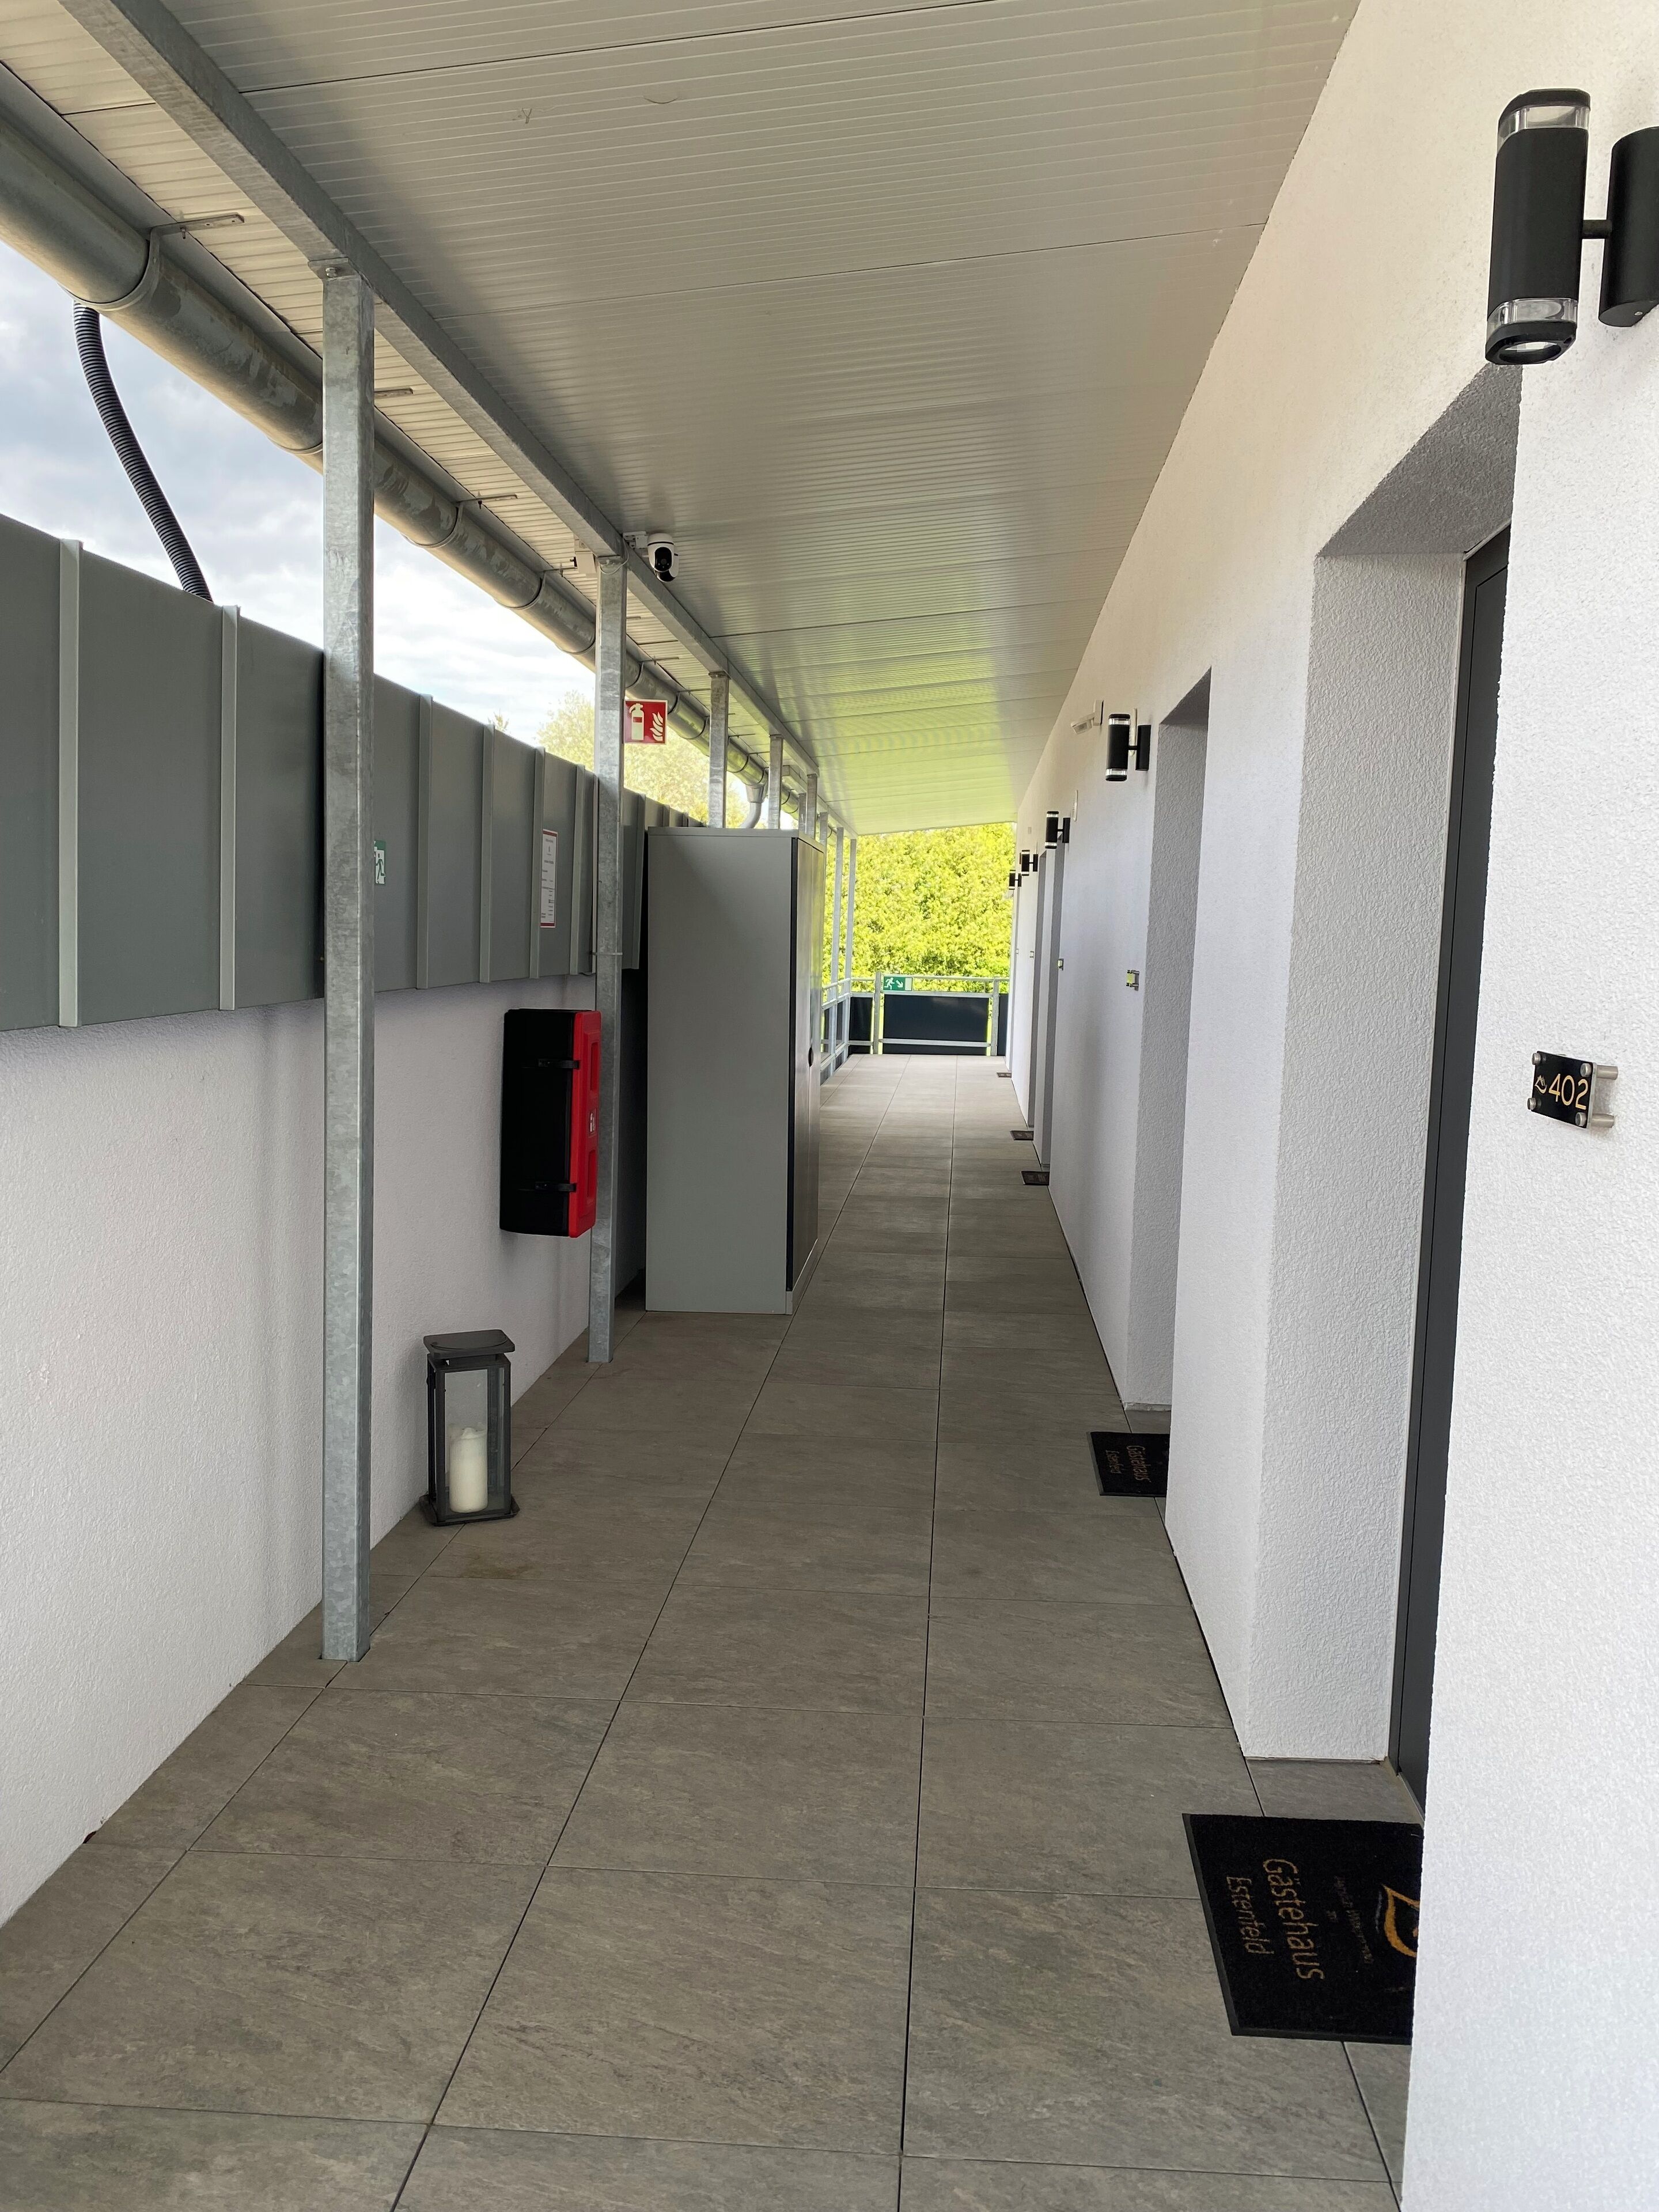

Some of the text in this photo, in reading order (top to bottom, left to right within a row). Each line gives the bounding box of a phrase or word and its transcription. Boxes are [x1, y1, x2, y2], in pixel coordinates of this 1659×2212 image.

[1548, 1073, 1588, 1110] 402
[1226, 1876, 1274, 1955] Estenfeld
[1263, 1858, 1324, 1980] Gästehaus
